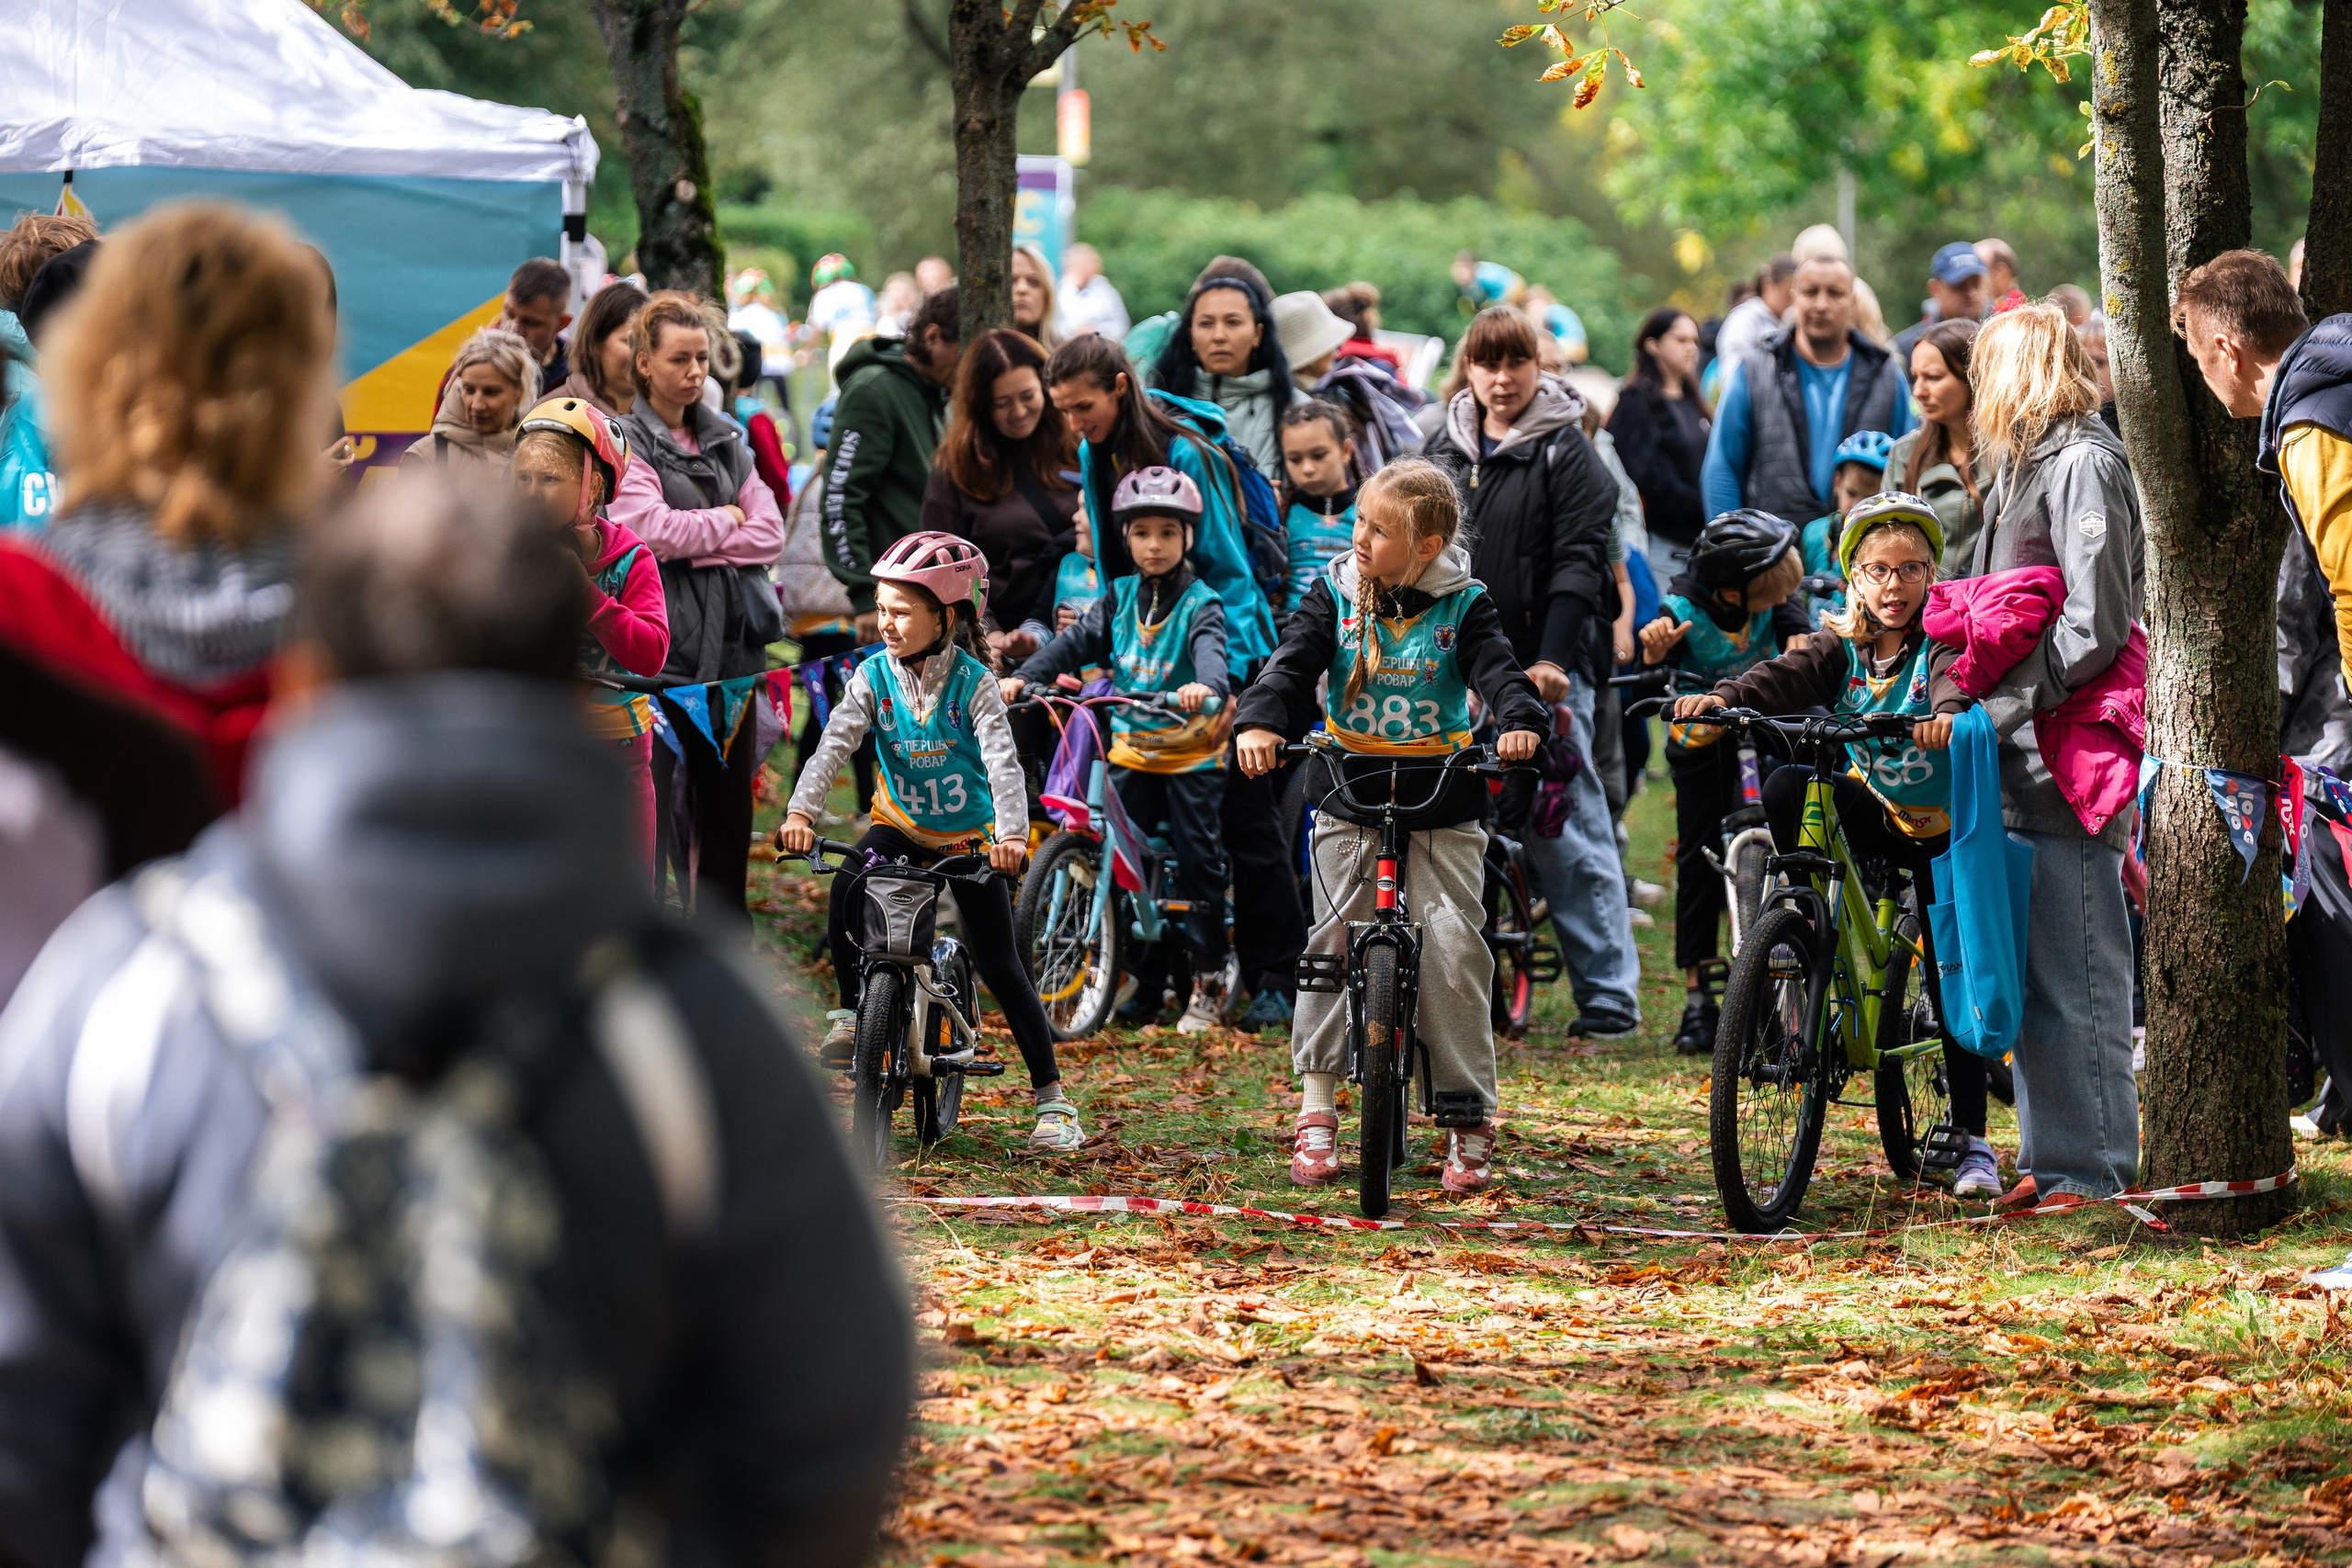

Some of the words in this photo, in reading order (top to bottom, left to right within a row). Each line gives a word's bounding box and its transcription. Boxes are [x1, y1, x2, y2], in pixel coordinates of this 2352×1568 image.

[1376, 672, 1416, 687] РОВАР
[1346, 693, 1441, 739] 883
[909, 754, 947, 770] РОВАР
[893, 773, 967, 816] 413
